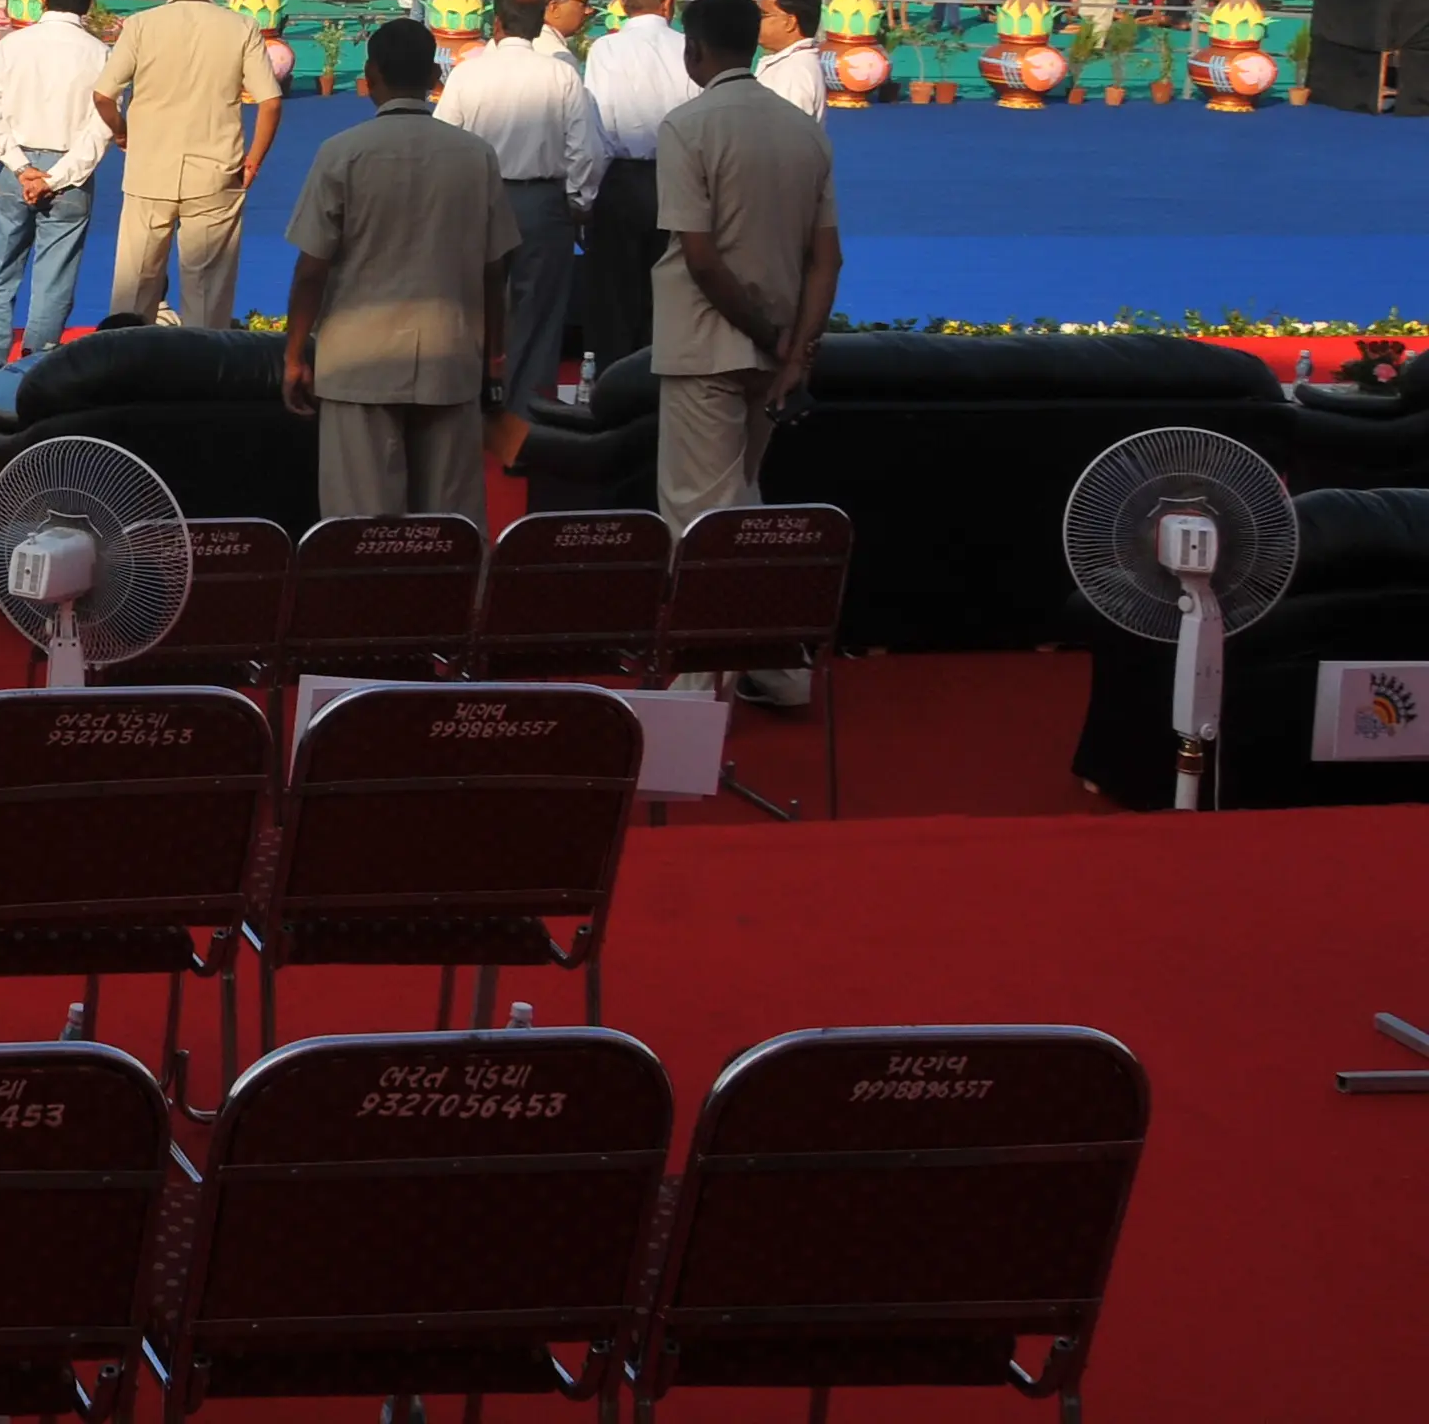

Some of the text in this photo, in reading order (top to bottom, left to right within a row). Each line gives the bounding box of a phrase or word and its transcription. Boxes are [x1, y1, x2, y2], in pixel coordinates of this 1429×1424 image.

[355, 540, 453, 555] 9327056453
[734, 532, 822, 546] 9327056453
[54, 712, 112, 729] ભરત
[428, 720, 559, 739] 9998896557
[45, 728, 194, 747] 9327056453
[378, 1064, 451, 1089] ભરત
[848, 1079, 994, 1103] 9998896557
[355, 1090, 568, 1120] 9327056453
